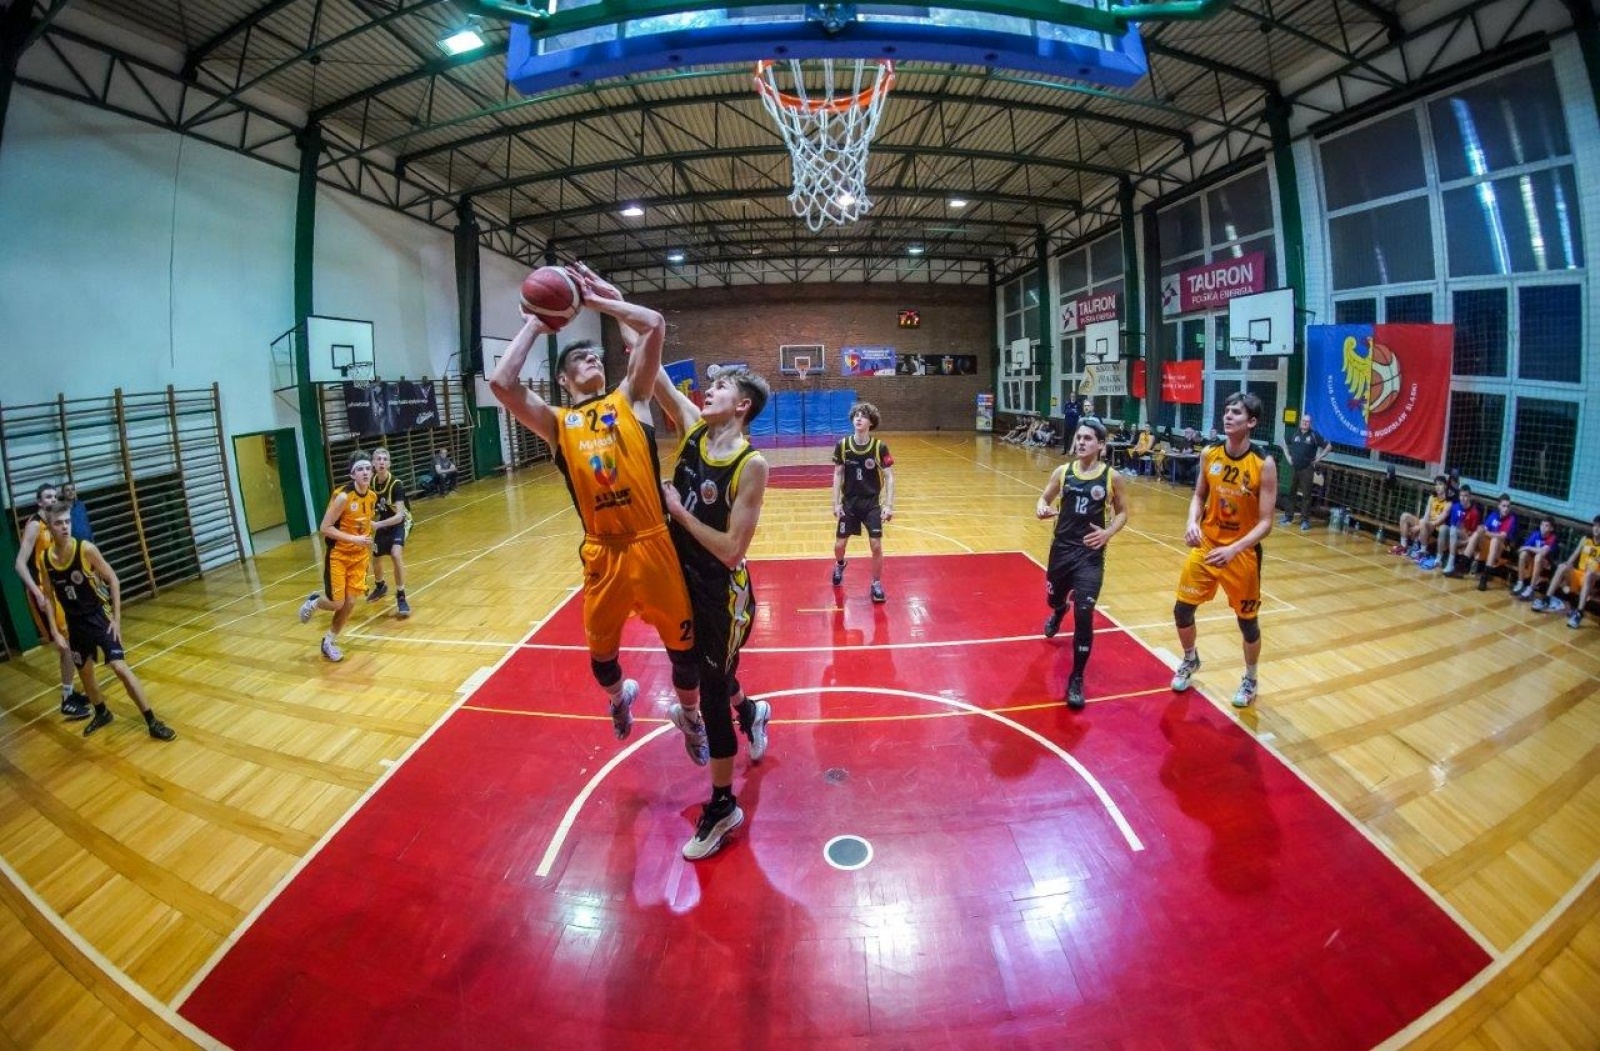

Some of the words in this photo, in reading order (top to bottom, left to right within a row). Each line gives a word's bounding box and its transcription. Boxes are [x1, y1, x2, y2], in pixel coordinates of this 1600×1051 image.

[1187, 262, 1253, 293] TAURON
[1220, 285, 1253, 299] ENERGIA
[1079, 294, 1116, 316] TAURON
[856, 468, 863, 480] 8
[1222, 465, 1240, 485] 22
[1075, 496, 1090, 514] 12
[680, 619, 692, 642] 2
